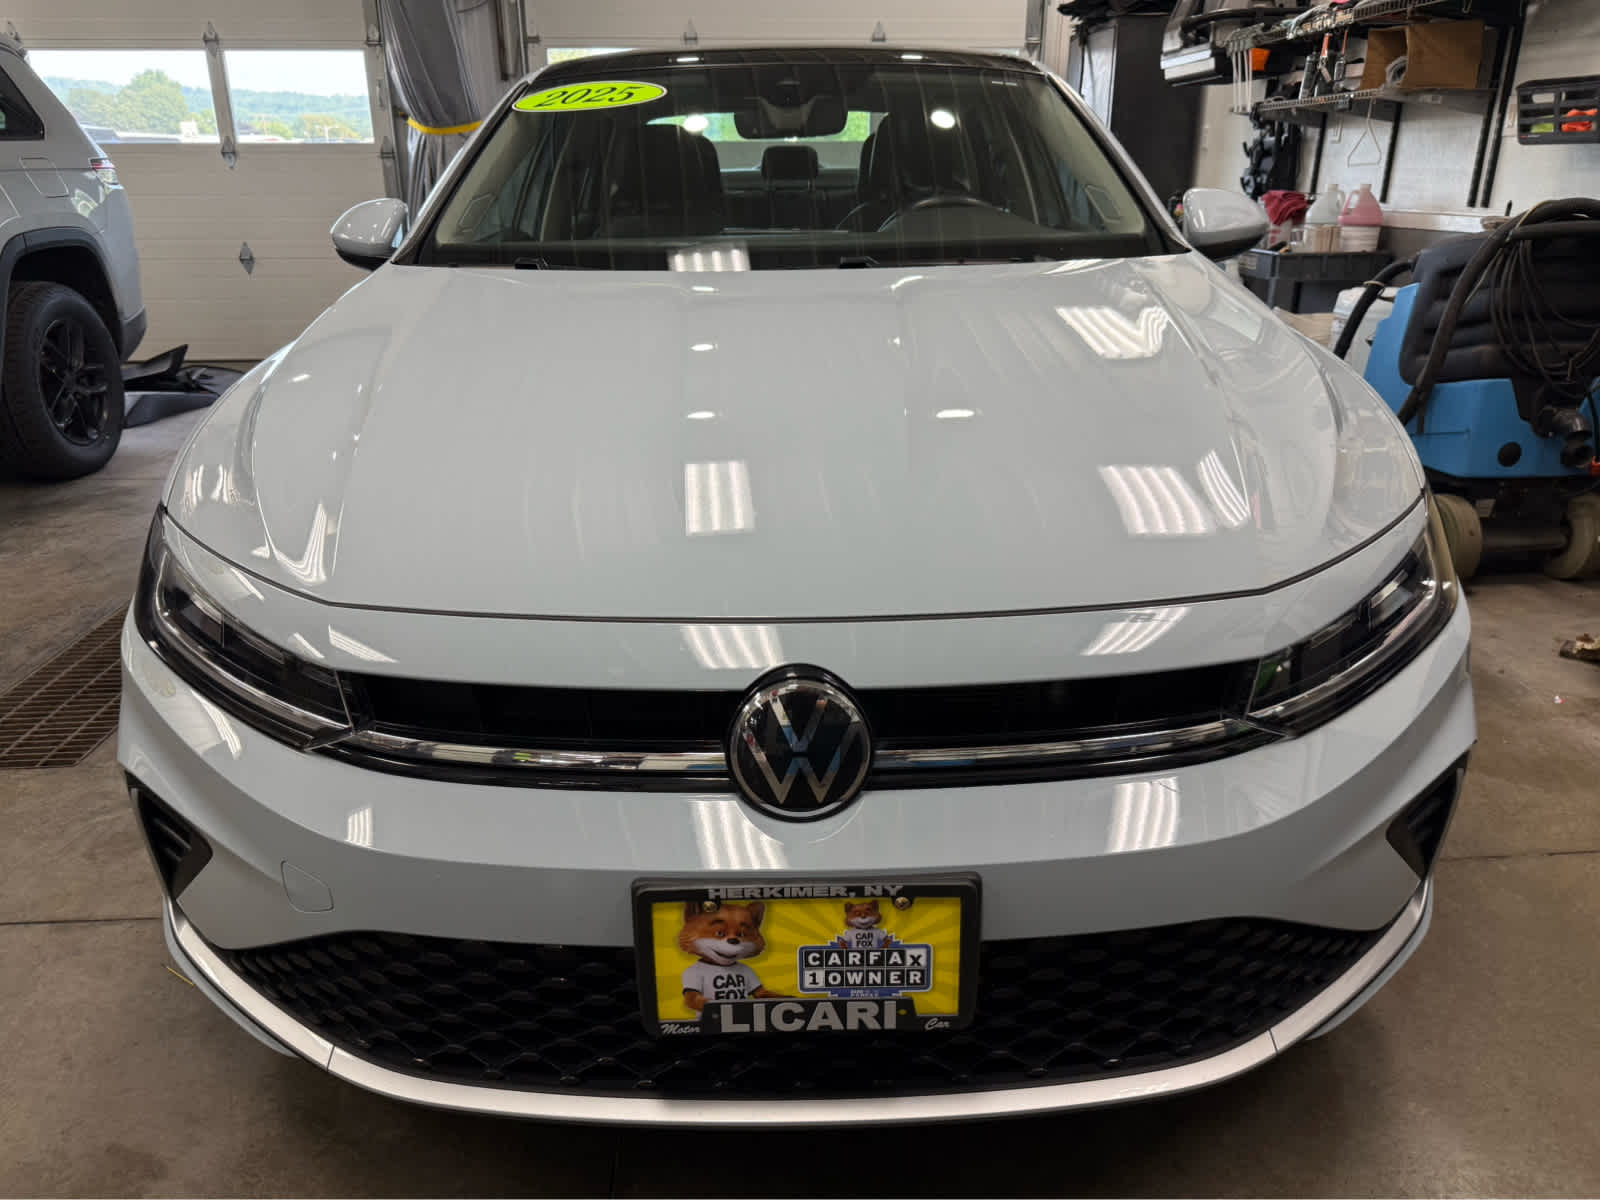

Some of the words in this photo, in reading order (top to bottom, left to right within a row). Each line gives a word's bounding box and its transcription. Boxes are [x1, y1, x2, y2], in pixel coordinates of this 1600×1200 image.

[533, 86, 642, 108] 2025
[741, 694, 861, 805] VW
[708, 885, 857, 900] HERKIMER,
[864, 884, 904, 897] NY
[855, 932, 874, 941] CAR
[856, 940, 873, 948] FOX
[807, 952, 923, 967] CARFAX
[712, 973, 746, 990] CAR
[808, 972, 821, 985] 1
[828, 971, 923, 985] OWNER
[714, 988, 748, 1000] FOX
[720, 1001, 897, 1033] LICARI
[924, 1017, 951, 1031] Car
[660, 1022, 701, 1035] Motor
